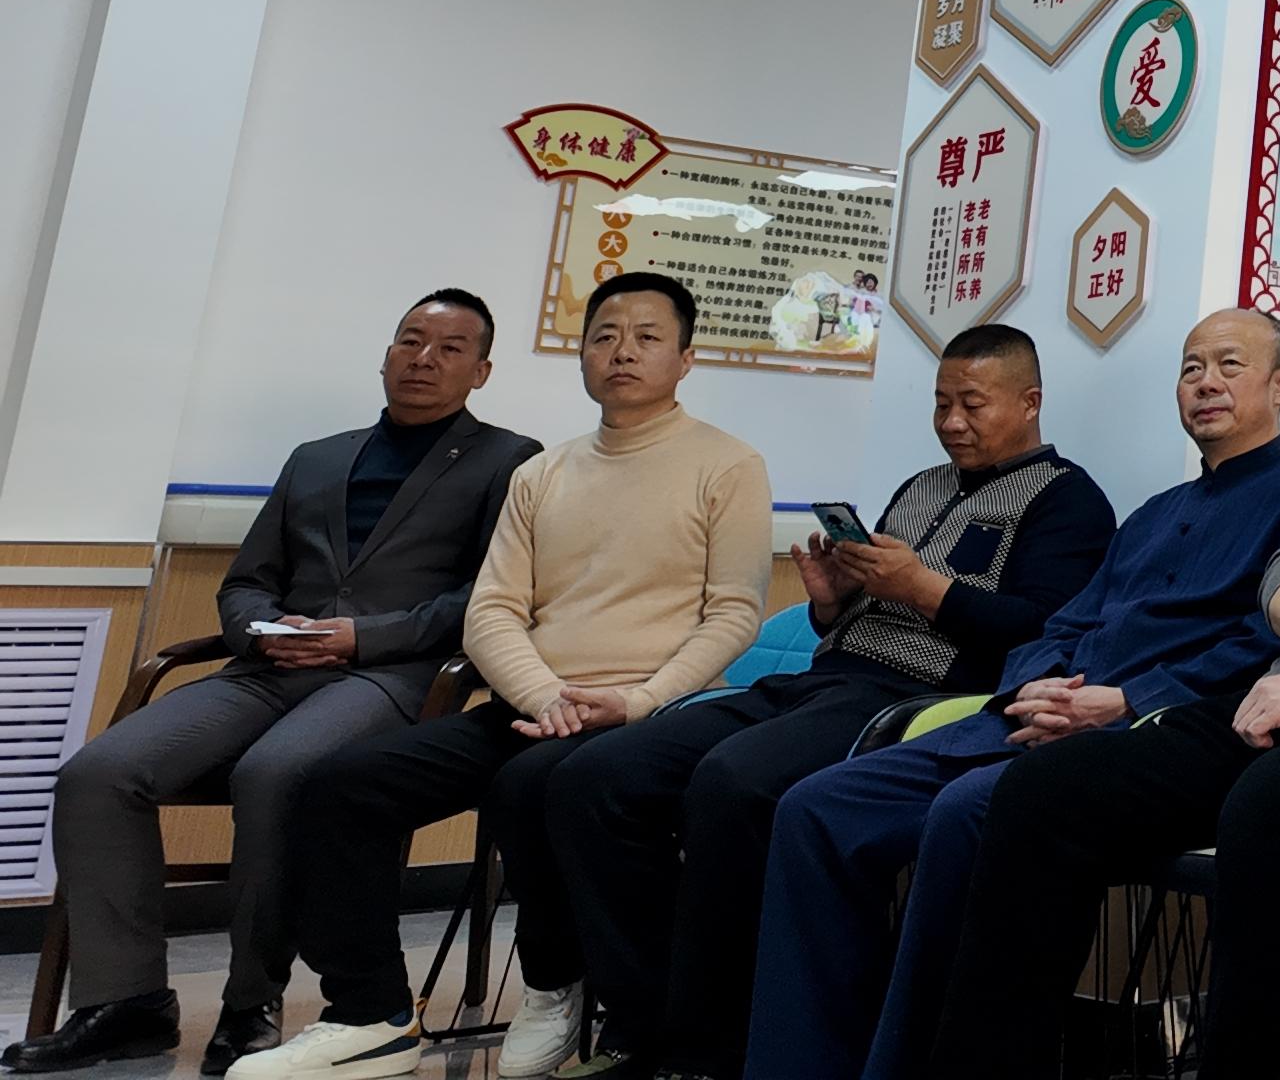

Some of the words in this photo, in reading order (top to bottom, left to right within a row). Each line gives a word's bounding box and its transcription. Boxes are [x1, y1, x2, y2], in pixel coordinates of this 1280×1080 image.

[1129, 36, 1166, 108] 爱
[532, 126, 637, 164] 身体健康
[936, 127, 1006, 189] 尊严
[954, 201, 976, 302] 老有所乐
[968, 198, 991, 301] 老有所养
[1091, 230, 1127, 263] 夕阳
[1087, 268, 1124, 300] 正好
